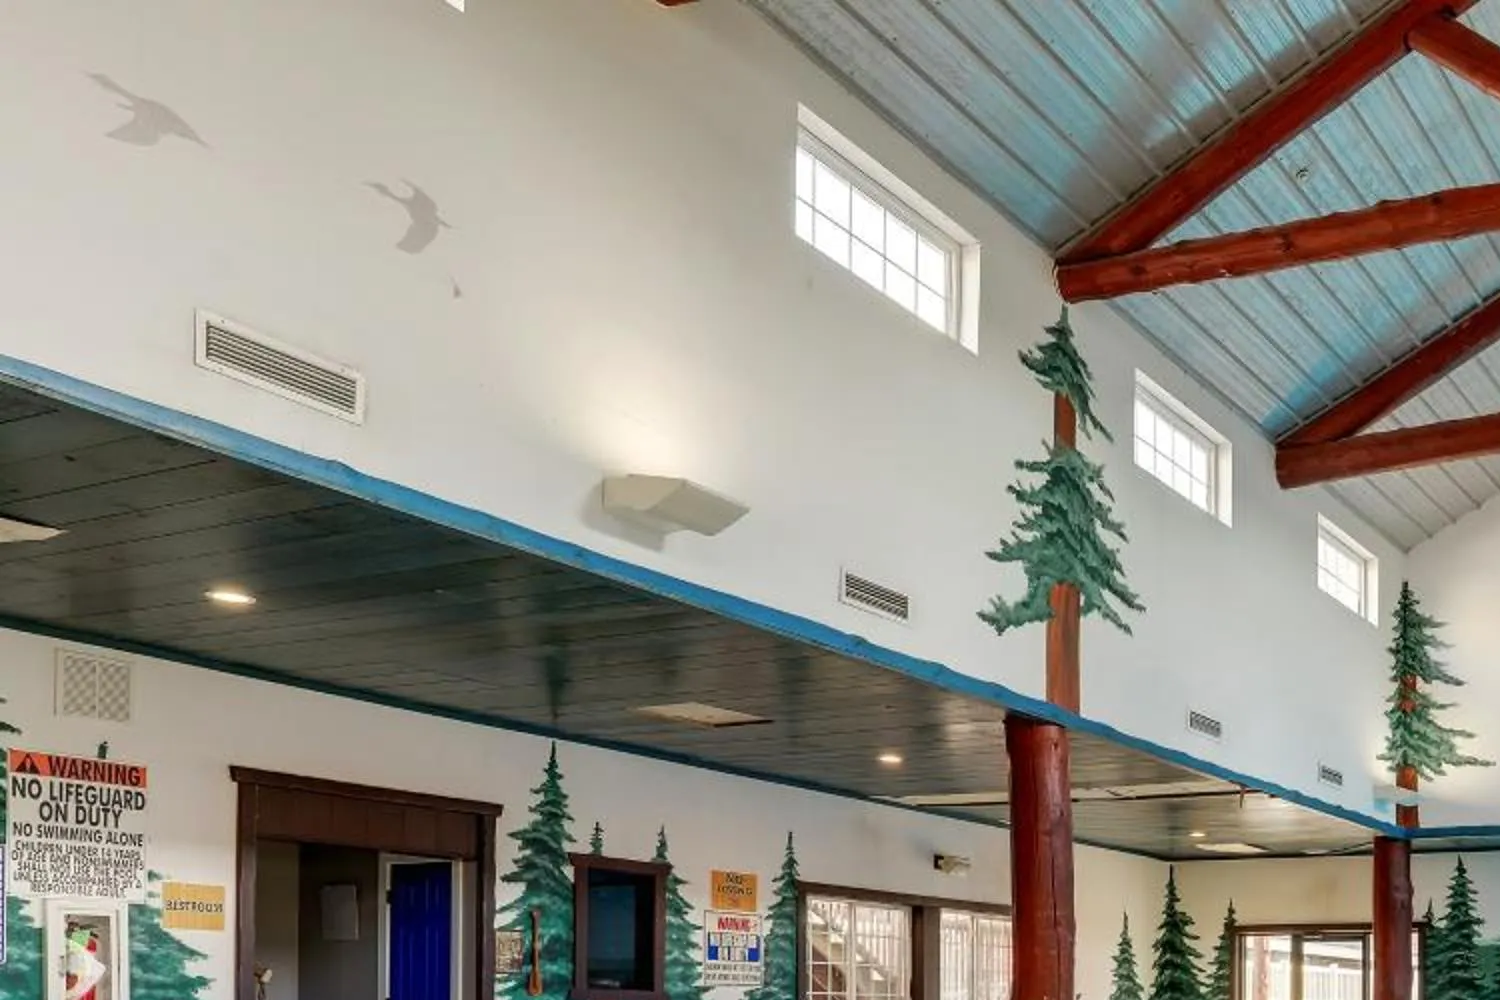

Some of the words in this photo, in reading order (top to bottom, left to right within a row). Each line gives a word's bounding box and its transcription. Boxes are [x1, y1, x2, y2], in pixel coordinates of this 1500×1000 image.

[48, 756, 141, 786] WARNING
[12, 776, 42, 800] NO
[49, 780, 145, 811] LIFEGUARD
[39, 801, 68, 823] ON
[75, 806, 123, 829] DUTY
[13, 822, 33, 837] NO
[36, 824, 102, 844] SWIMMING
[106, 832, 144, 846] ALONE
[15, 839, 63, 853] CHILDREN
[66, 844, 98, 856] UNDER
